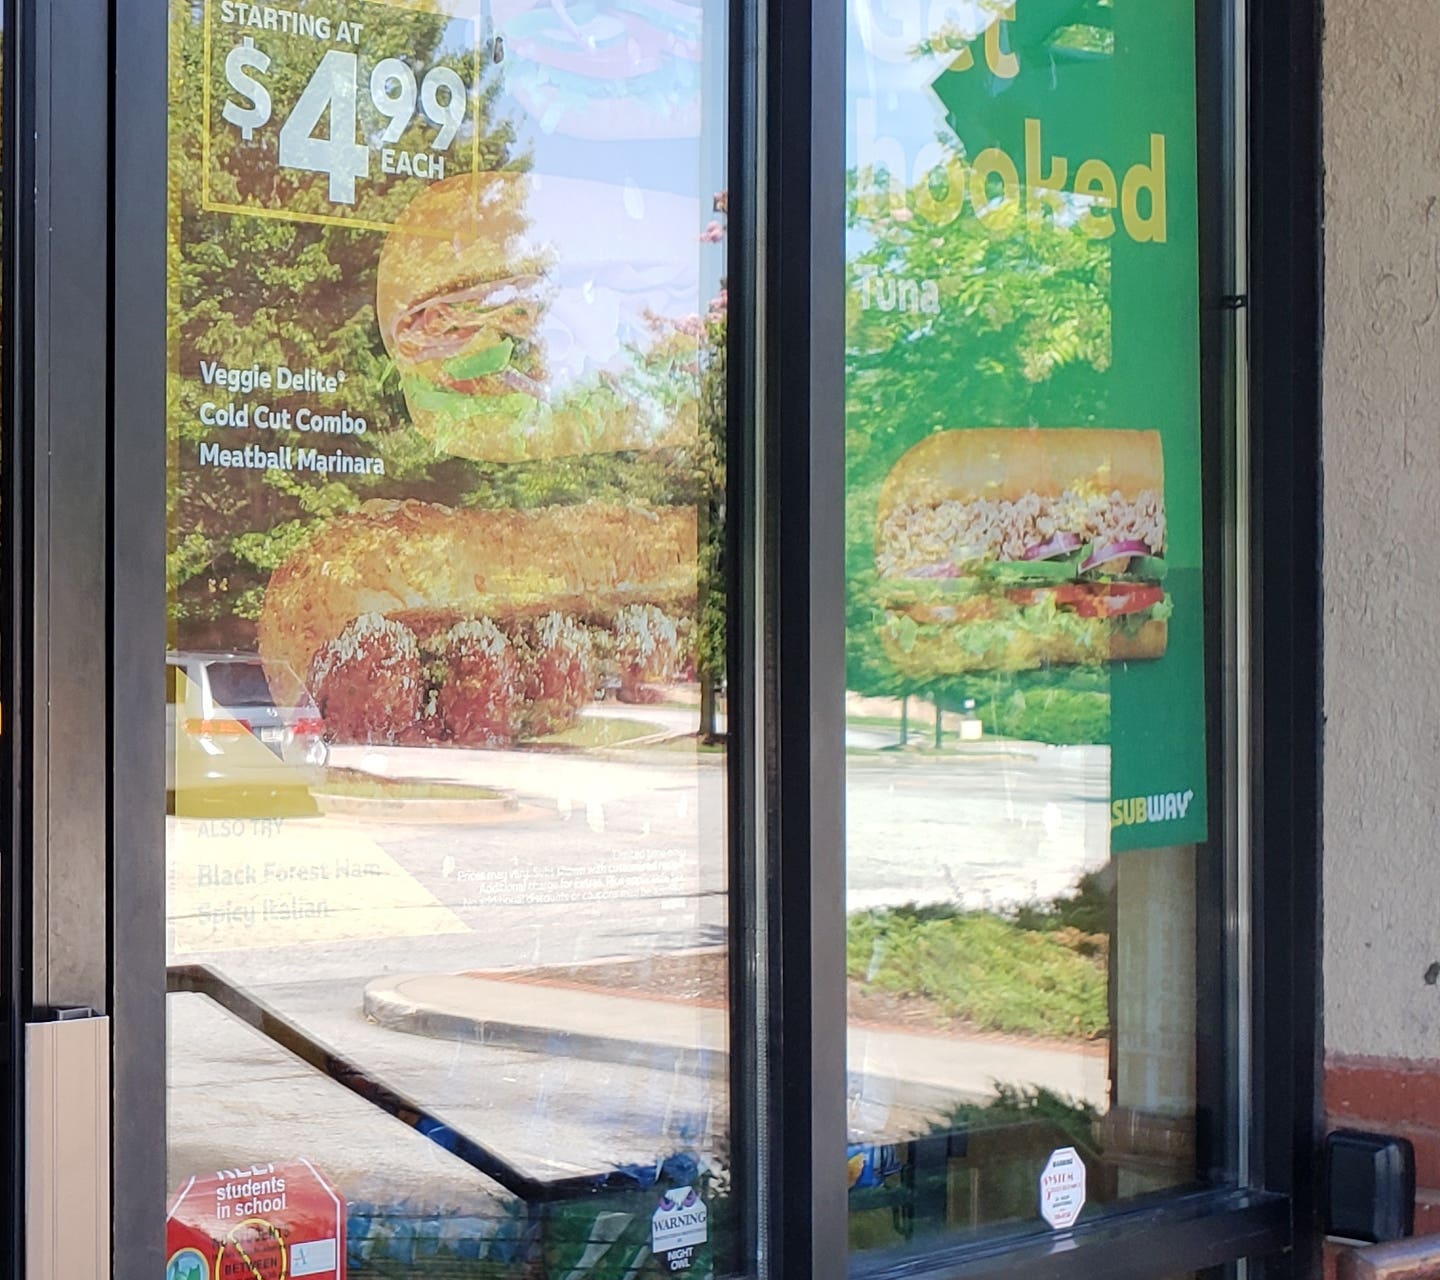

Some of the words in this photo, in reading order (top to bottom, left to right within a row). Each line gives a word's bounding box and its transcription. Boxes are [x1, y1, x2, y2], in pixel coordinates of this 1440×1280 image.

[221, 0, 330, 40] STARTING
[334, 22, 364, 45] AT
[380, 148, 446, 181] EACH
[855, 96, 1168, 245] hooked
[857, 262, 940, 315] Tuna
[200, 361, 272, 393] Veggie
[199, 402, 249, 427] Cold
[254, 405, 291, 430] Cut
[296, 408, 367, 435] Combo
[199, 442, 292, 471] Meatball
[297, 448, 385, 475] Marinara
[1111, 789, 1193, 829] SUBWAY
[198, 820, 245, 838] ALSO
[251, 817, 286, 838] TRY
[197, 864, 257, 887] Black
[263, 862, 330, 882] Forest
[335, 859, 382, 880] Ham
[197, 901, 256, 927] Spicy
[263, 898, 331, 921] Italian
[216, 1176, 286, 1201] students
[216, 1202, 231, 1219] in
[235, 1193, 287, 1217] school
[653, 1211, 707, 1232] WARNING
[667, 1247, 694, 1262] NIGHT
[670, 1258, 691, 1271] OWL
